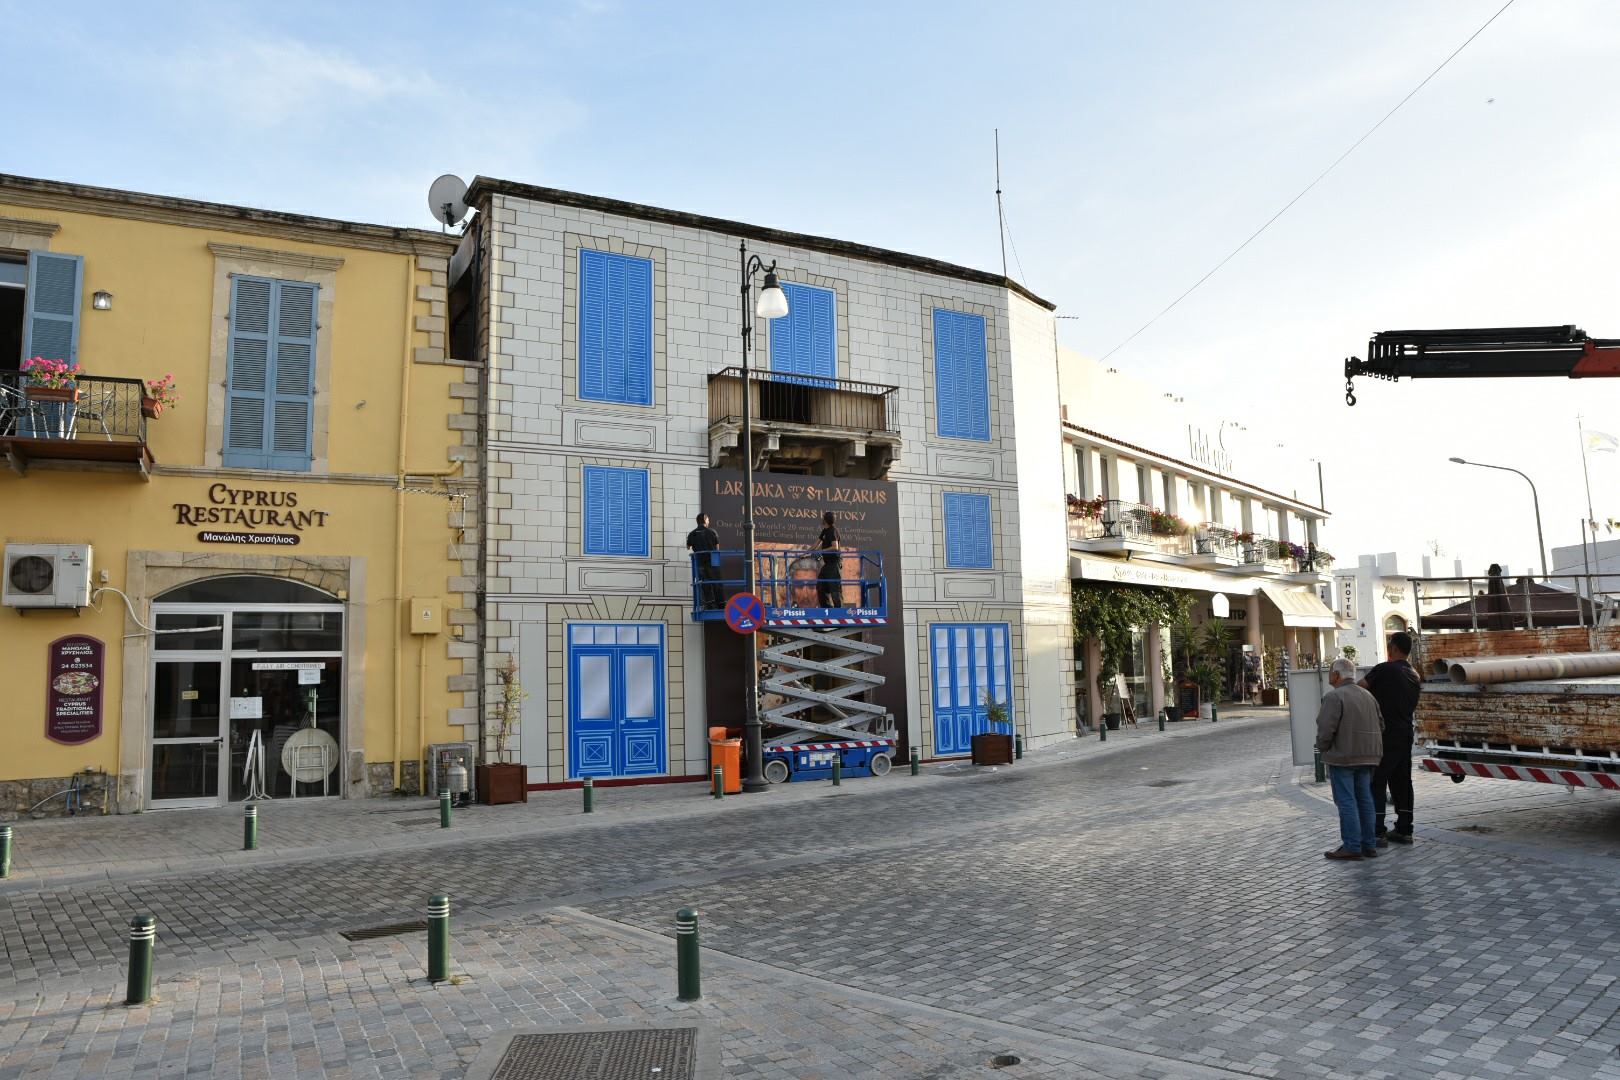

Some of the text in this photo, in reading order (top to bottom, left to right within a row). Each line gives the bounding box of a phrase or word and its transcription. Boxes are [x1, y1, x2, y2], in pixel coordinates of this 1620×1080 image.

[208, 483, 298, 507] CYPRUS
[715, 480, 785, 498] LARAKA
[826, 487, 887, 506] LAZARUS
[173, 503, 329, 531] RESTAURANT
[782, 506, 818, 519] YEARS
[203, 532, 294, 545] Μανώλης Χρυσήλιος
[783, 608, 806, 617] Pissis
[856, 608, 878, 616] Pissis
